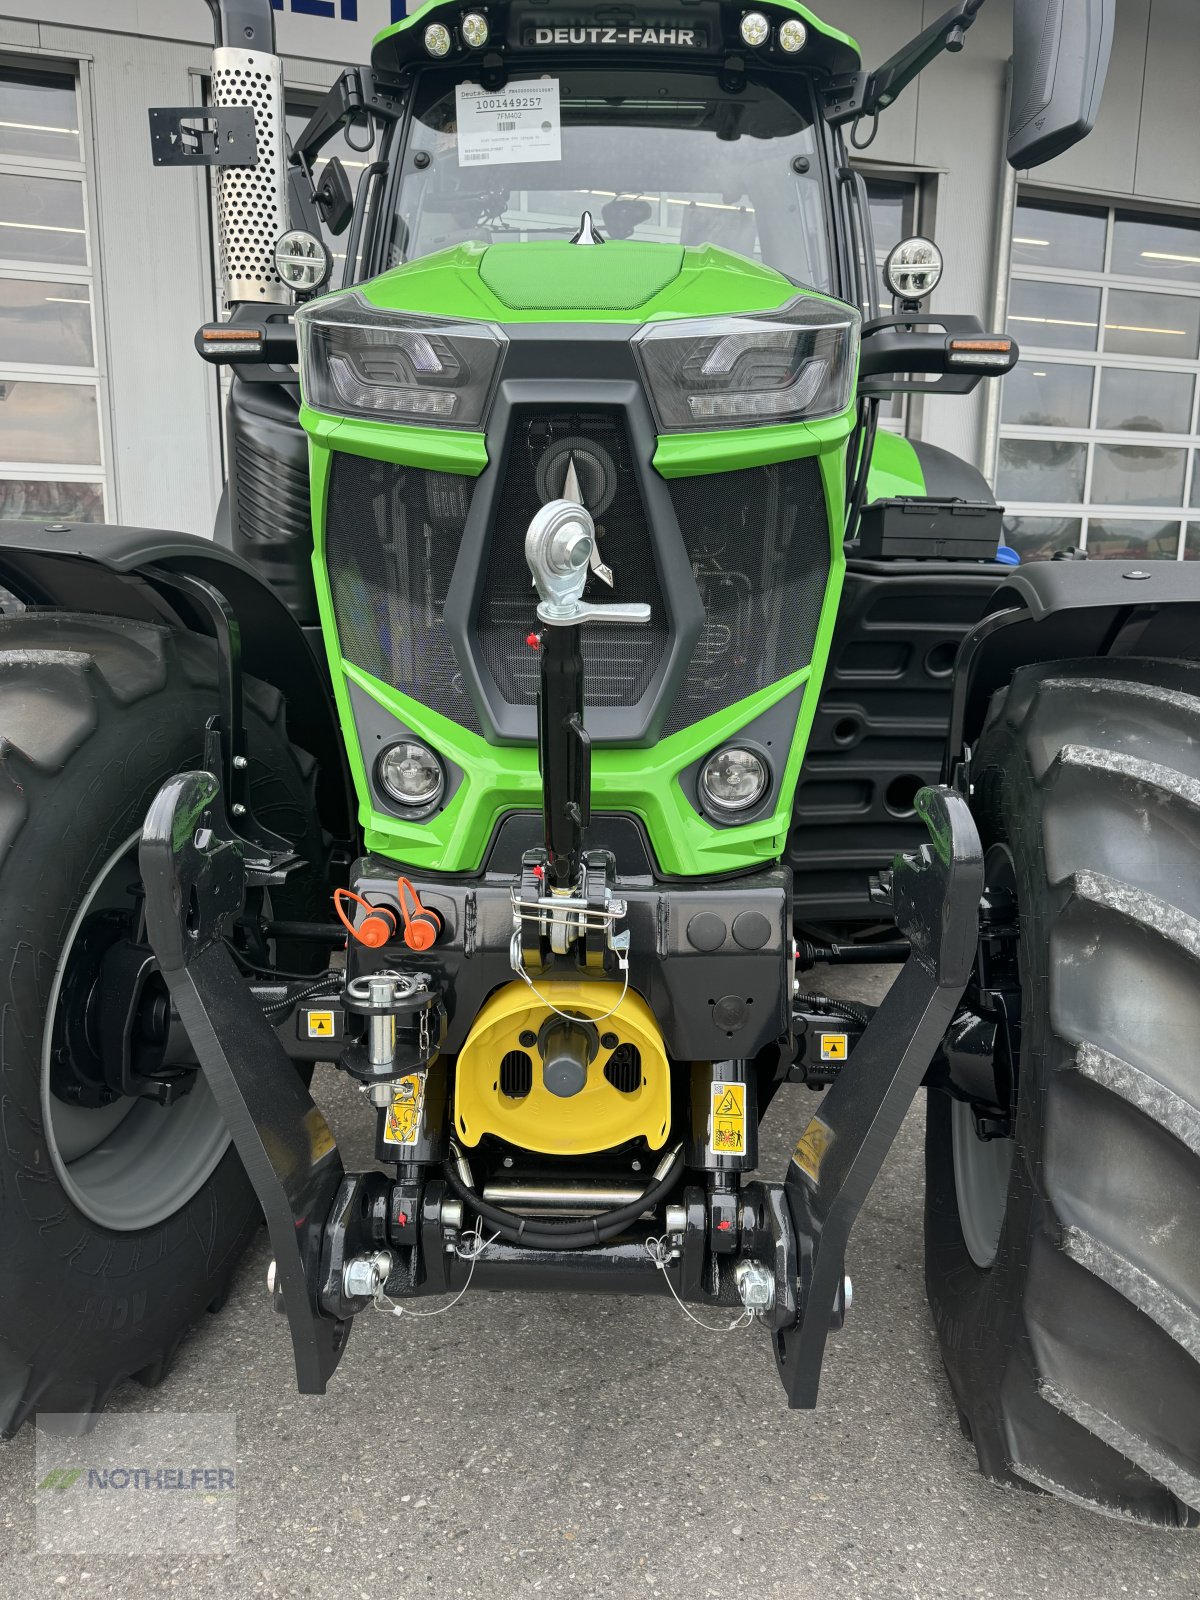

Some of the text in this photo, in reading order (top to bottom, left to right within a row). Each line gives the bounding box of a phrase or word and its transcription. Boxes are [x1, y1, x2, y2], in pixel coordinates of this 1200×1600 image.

[535, 28, 694, 45] DEUTZ-FAHR
[476, 97, 542, 110] 1001449257
[497, 112, 522, 120] 7FM402
